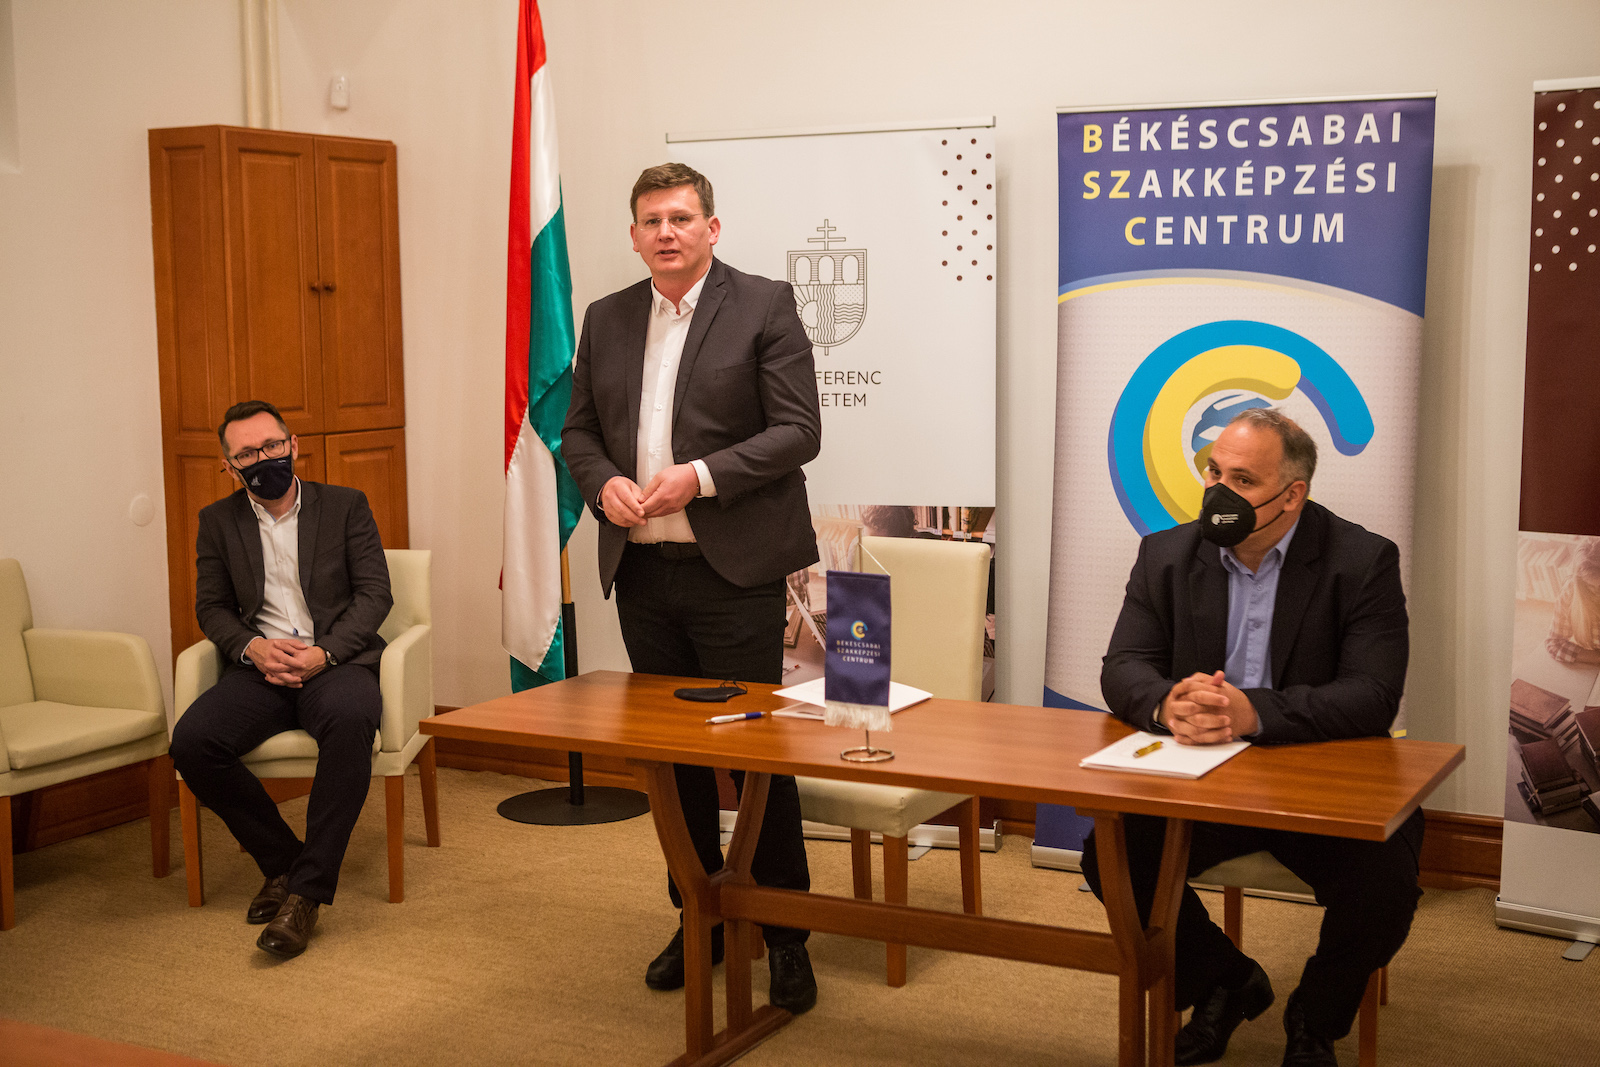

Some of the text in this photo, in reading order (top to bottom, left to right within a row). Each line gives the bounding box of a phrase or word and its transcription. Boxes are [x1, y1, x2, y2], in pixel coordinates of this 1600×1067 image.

[1083, 112, 1401, 153] BÉKÉSCSABAI
[1083, 157, 1396, 199] SZAKKÉPZÉSI
[1124, 213, 1344, 246] CENTRUM
[818, 393, 866, 407] ETEM
[842, 656, 874, 664] CENTRUM
